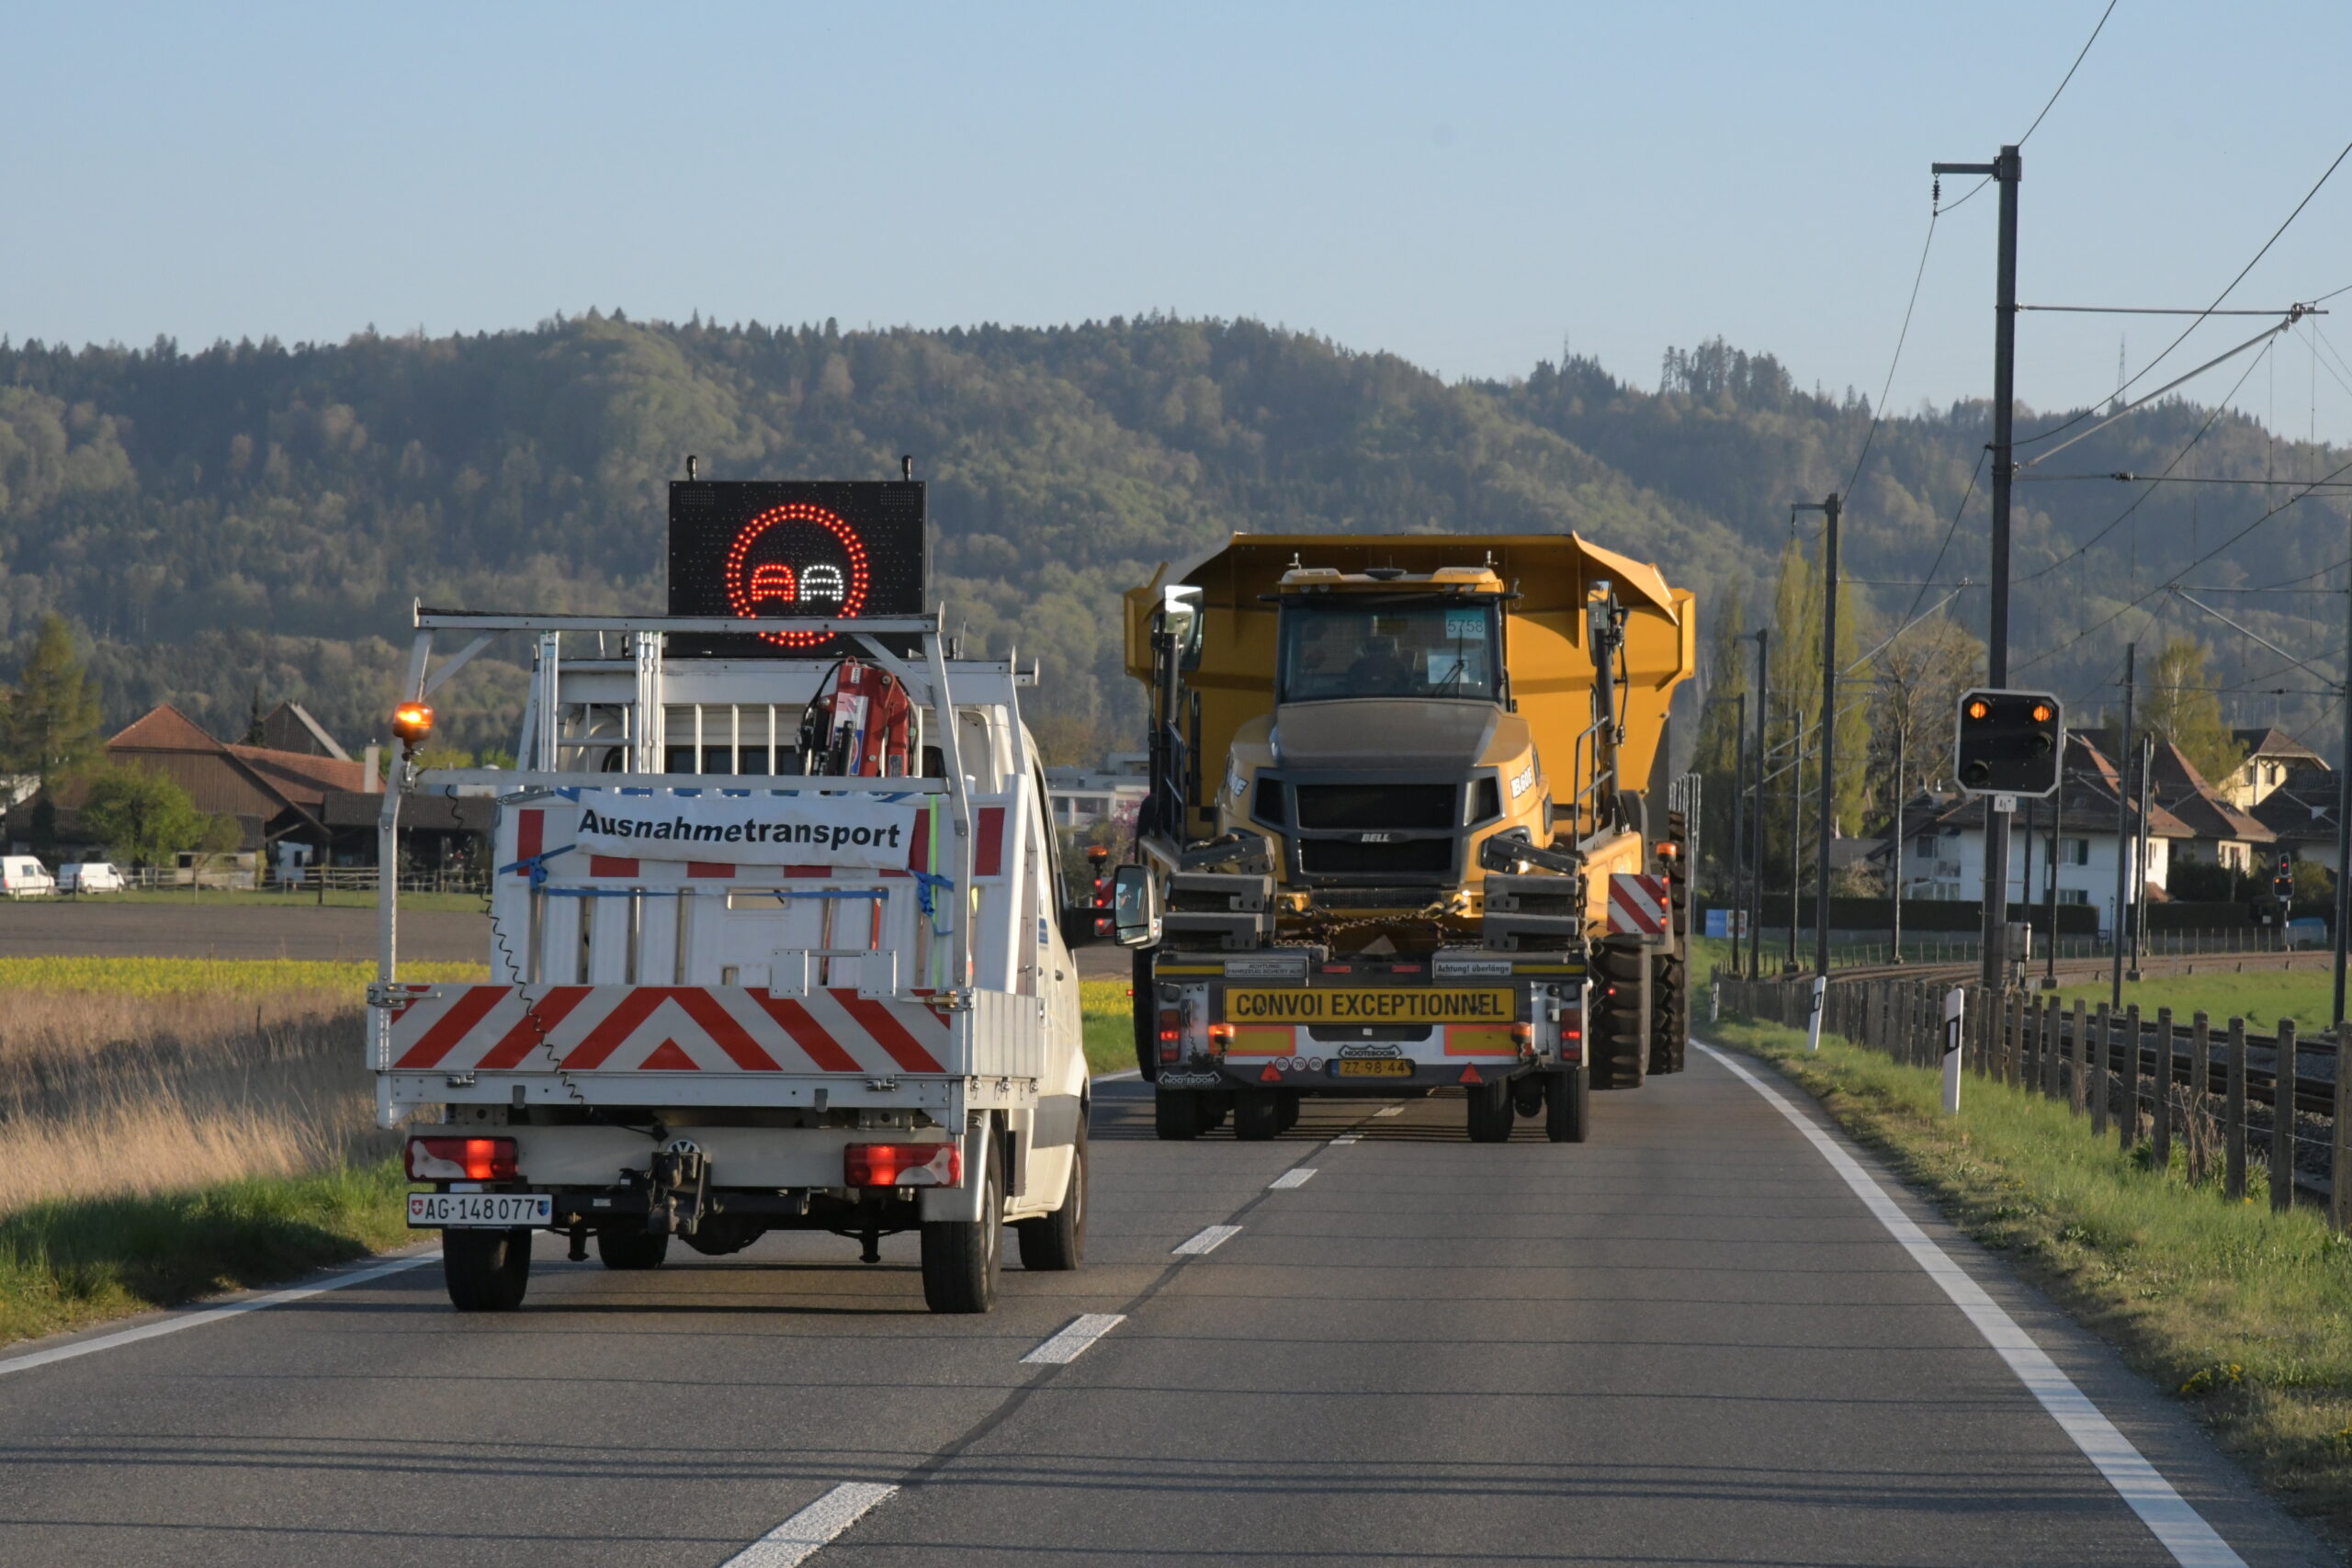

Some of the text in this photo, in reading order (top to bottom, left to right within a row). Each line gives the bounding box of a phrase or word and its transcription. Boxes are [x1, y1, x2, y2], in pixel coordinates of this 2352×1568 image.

[1448, 619, 1484, 633] 5758
[578, 809, 900, 851] Ausnahmetransport
[1361, 833, 1389, 842] BELL
[1438, 964, 1470, 974] Achtung!
[1237, 994, 1505, 1016] CONVOI EXCEPTIONNEL
[1344, 1062, 1405, 1074] ZZ-98-44
